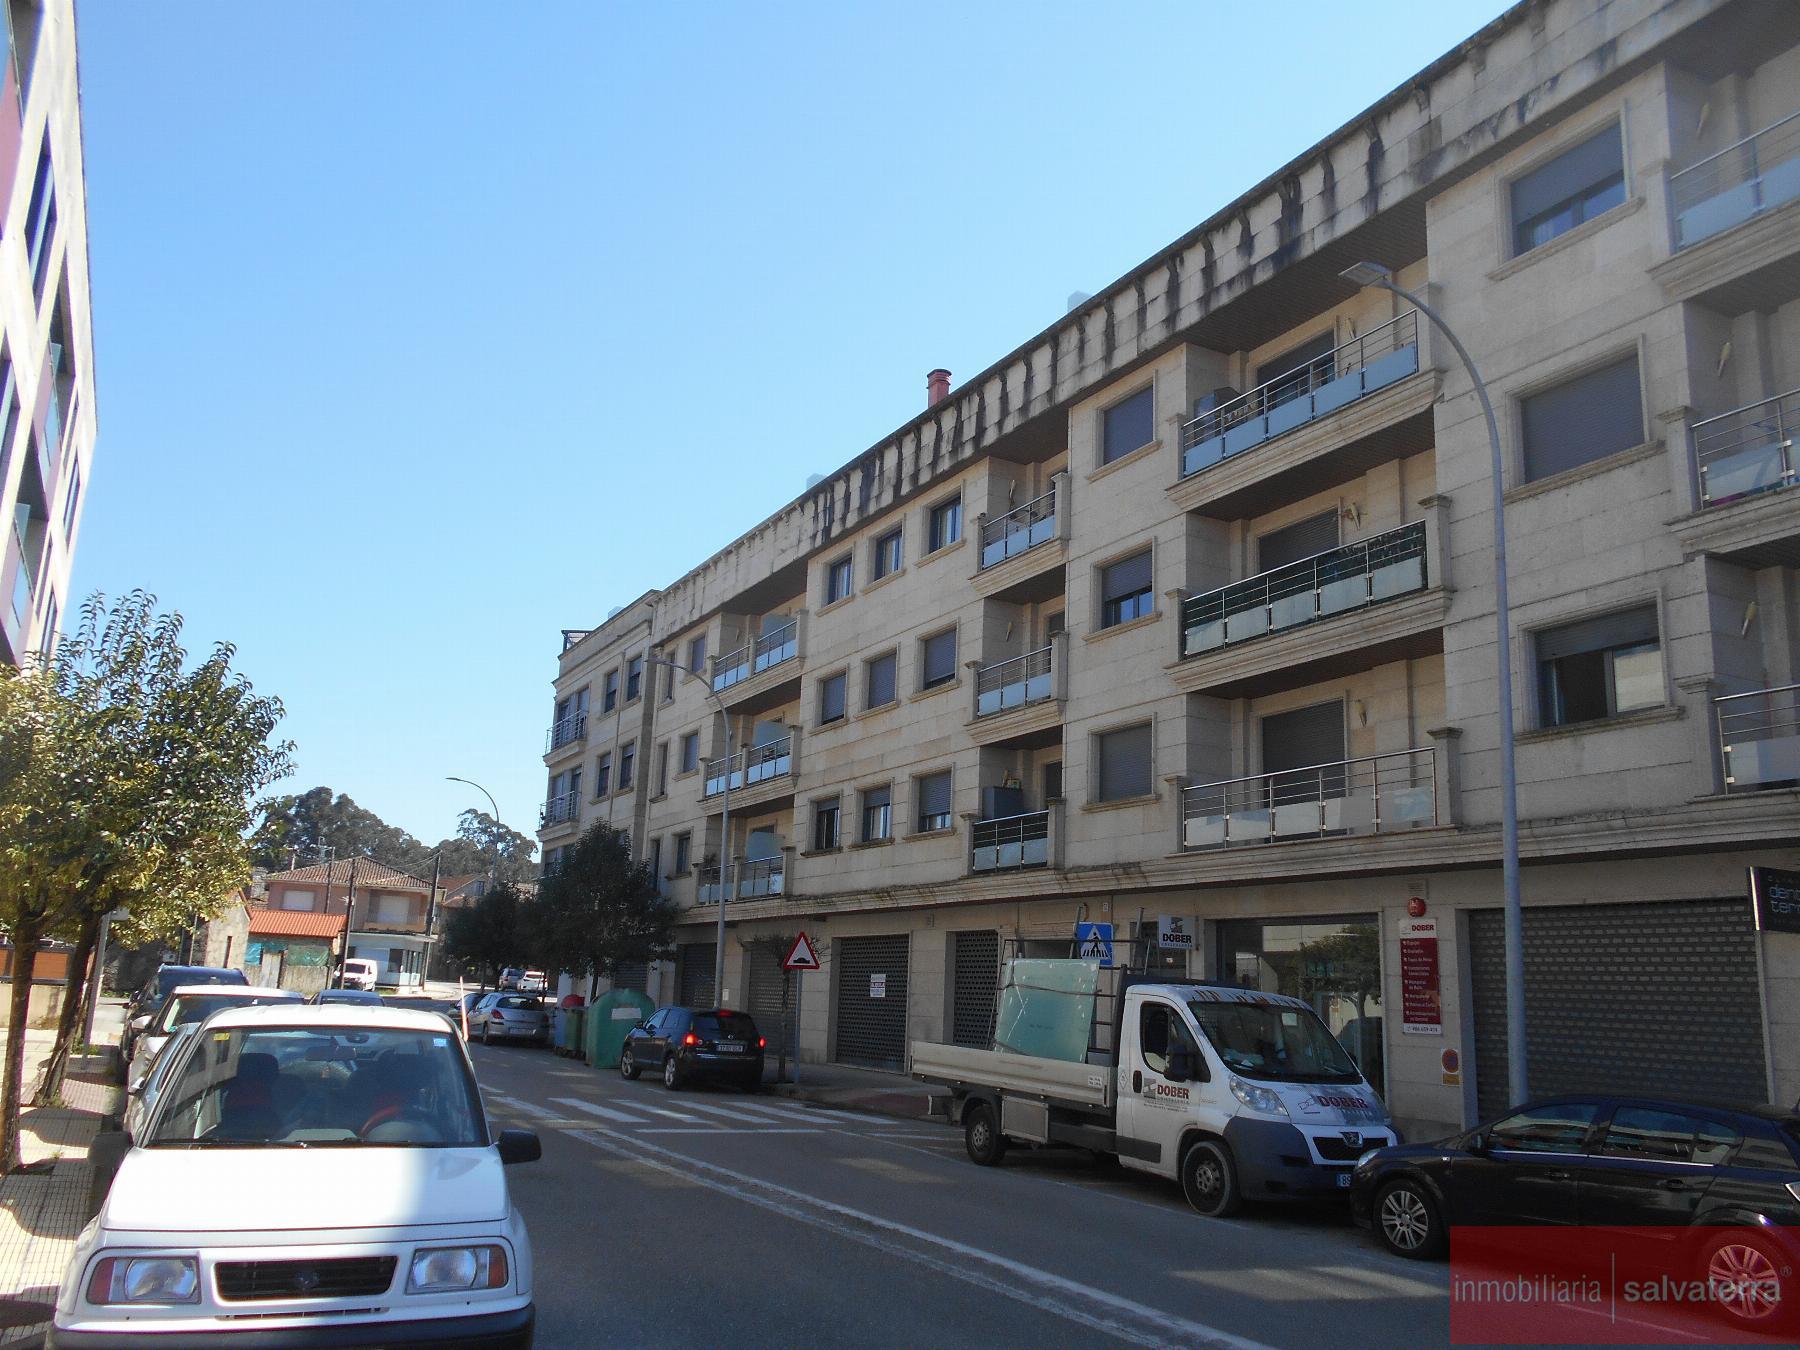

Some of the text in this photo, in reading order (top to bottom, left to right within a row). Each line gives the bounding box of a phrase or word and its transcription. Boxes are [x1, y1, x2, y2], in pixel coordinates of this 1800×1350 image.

[1162, 933, 1192, 943] DOBER
[1157, 1084, 1190, 1099] DOBER
[1317, 1096, 1368, 1108] DOBER
